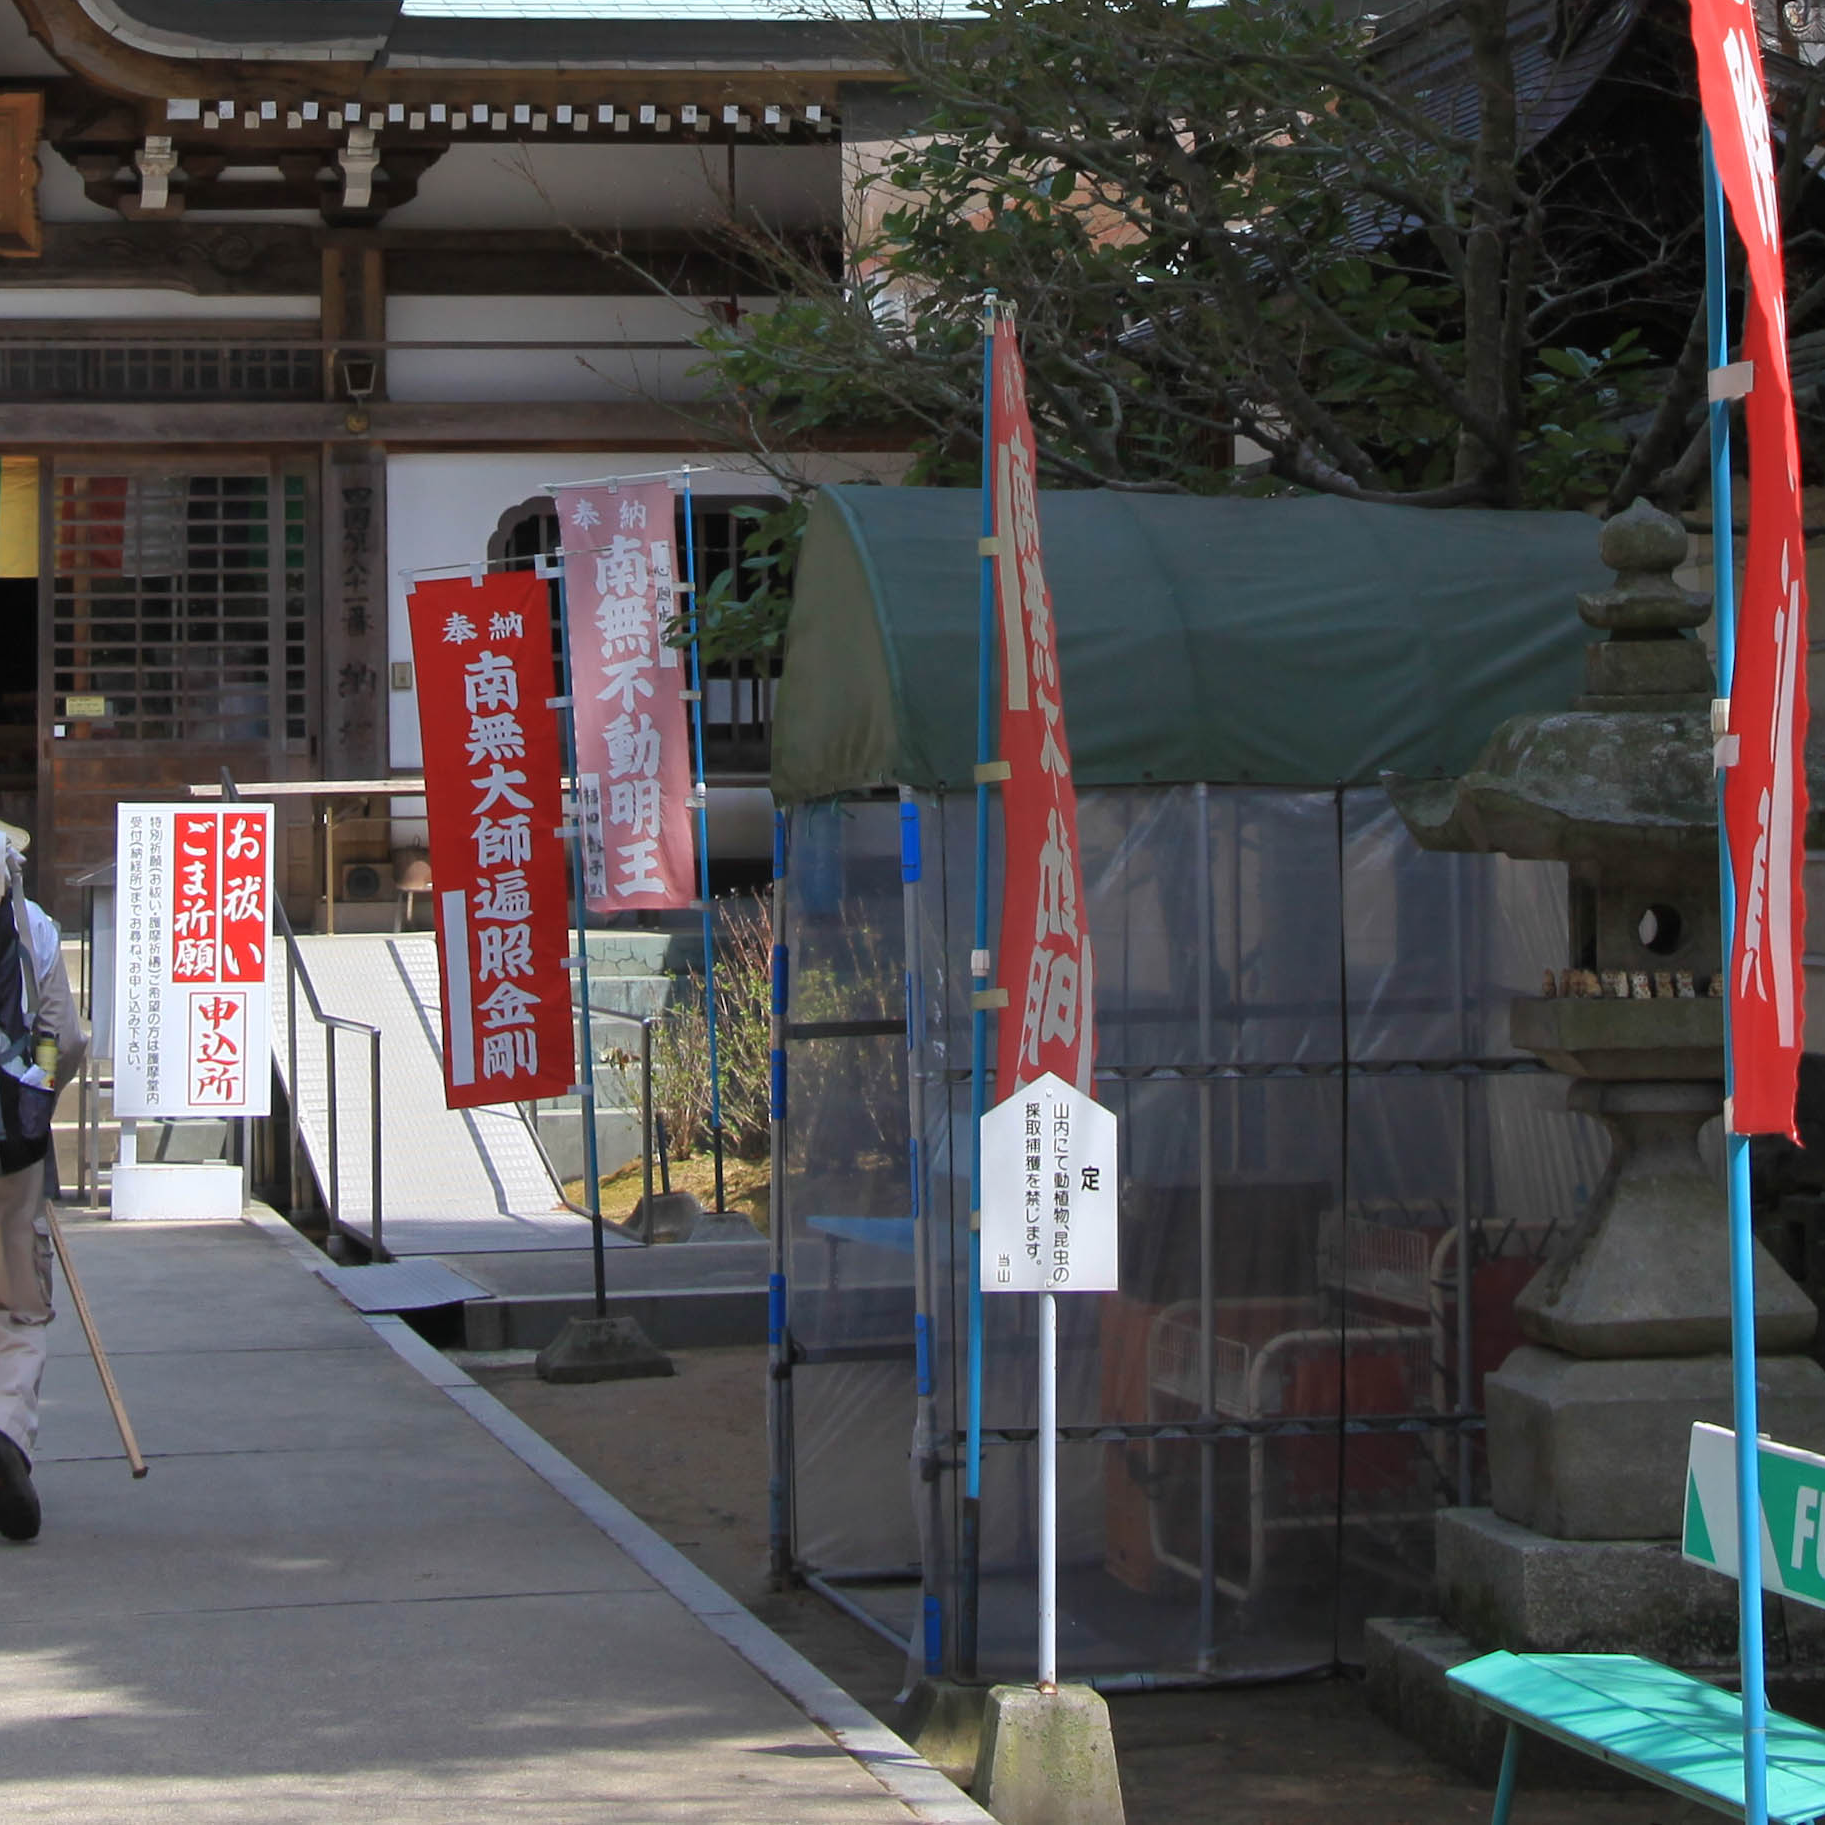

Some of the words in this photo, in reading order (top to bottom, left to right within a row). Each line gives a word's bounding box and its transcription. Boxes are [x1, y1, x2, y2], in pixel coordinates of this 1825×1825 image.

[571, 497, 647, 531] 奉納
[442, 611, 524, 645] 奉納
[594, 534, 667, 898] 南無不動明王
[173, 820, 215, 977] ごま祈願
[222, 817, 266, 975] お祓い
[464, 650, 542, 1079] 南無大師遍照金剛
[196, 996, 240, 1101] 申込所
[1025, 1102, 1042, 1266] 採取捕獲を禁じます。
[1053, 1102, 1070, 1283] 山内にて動植物、昆虫の
[1080, 1165, 1100, 1191] 定
[997, 1253, 1011, 1283] 当山
